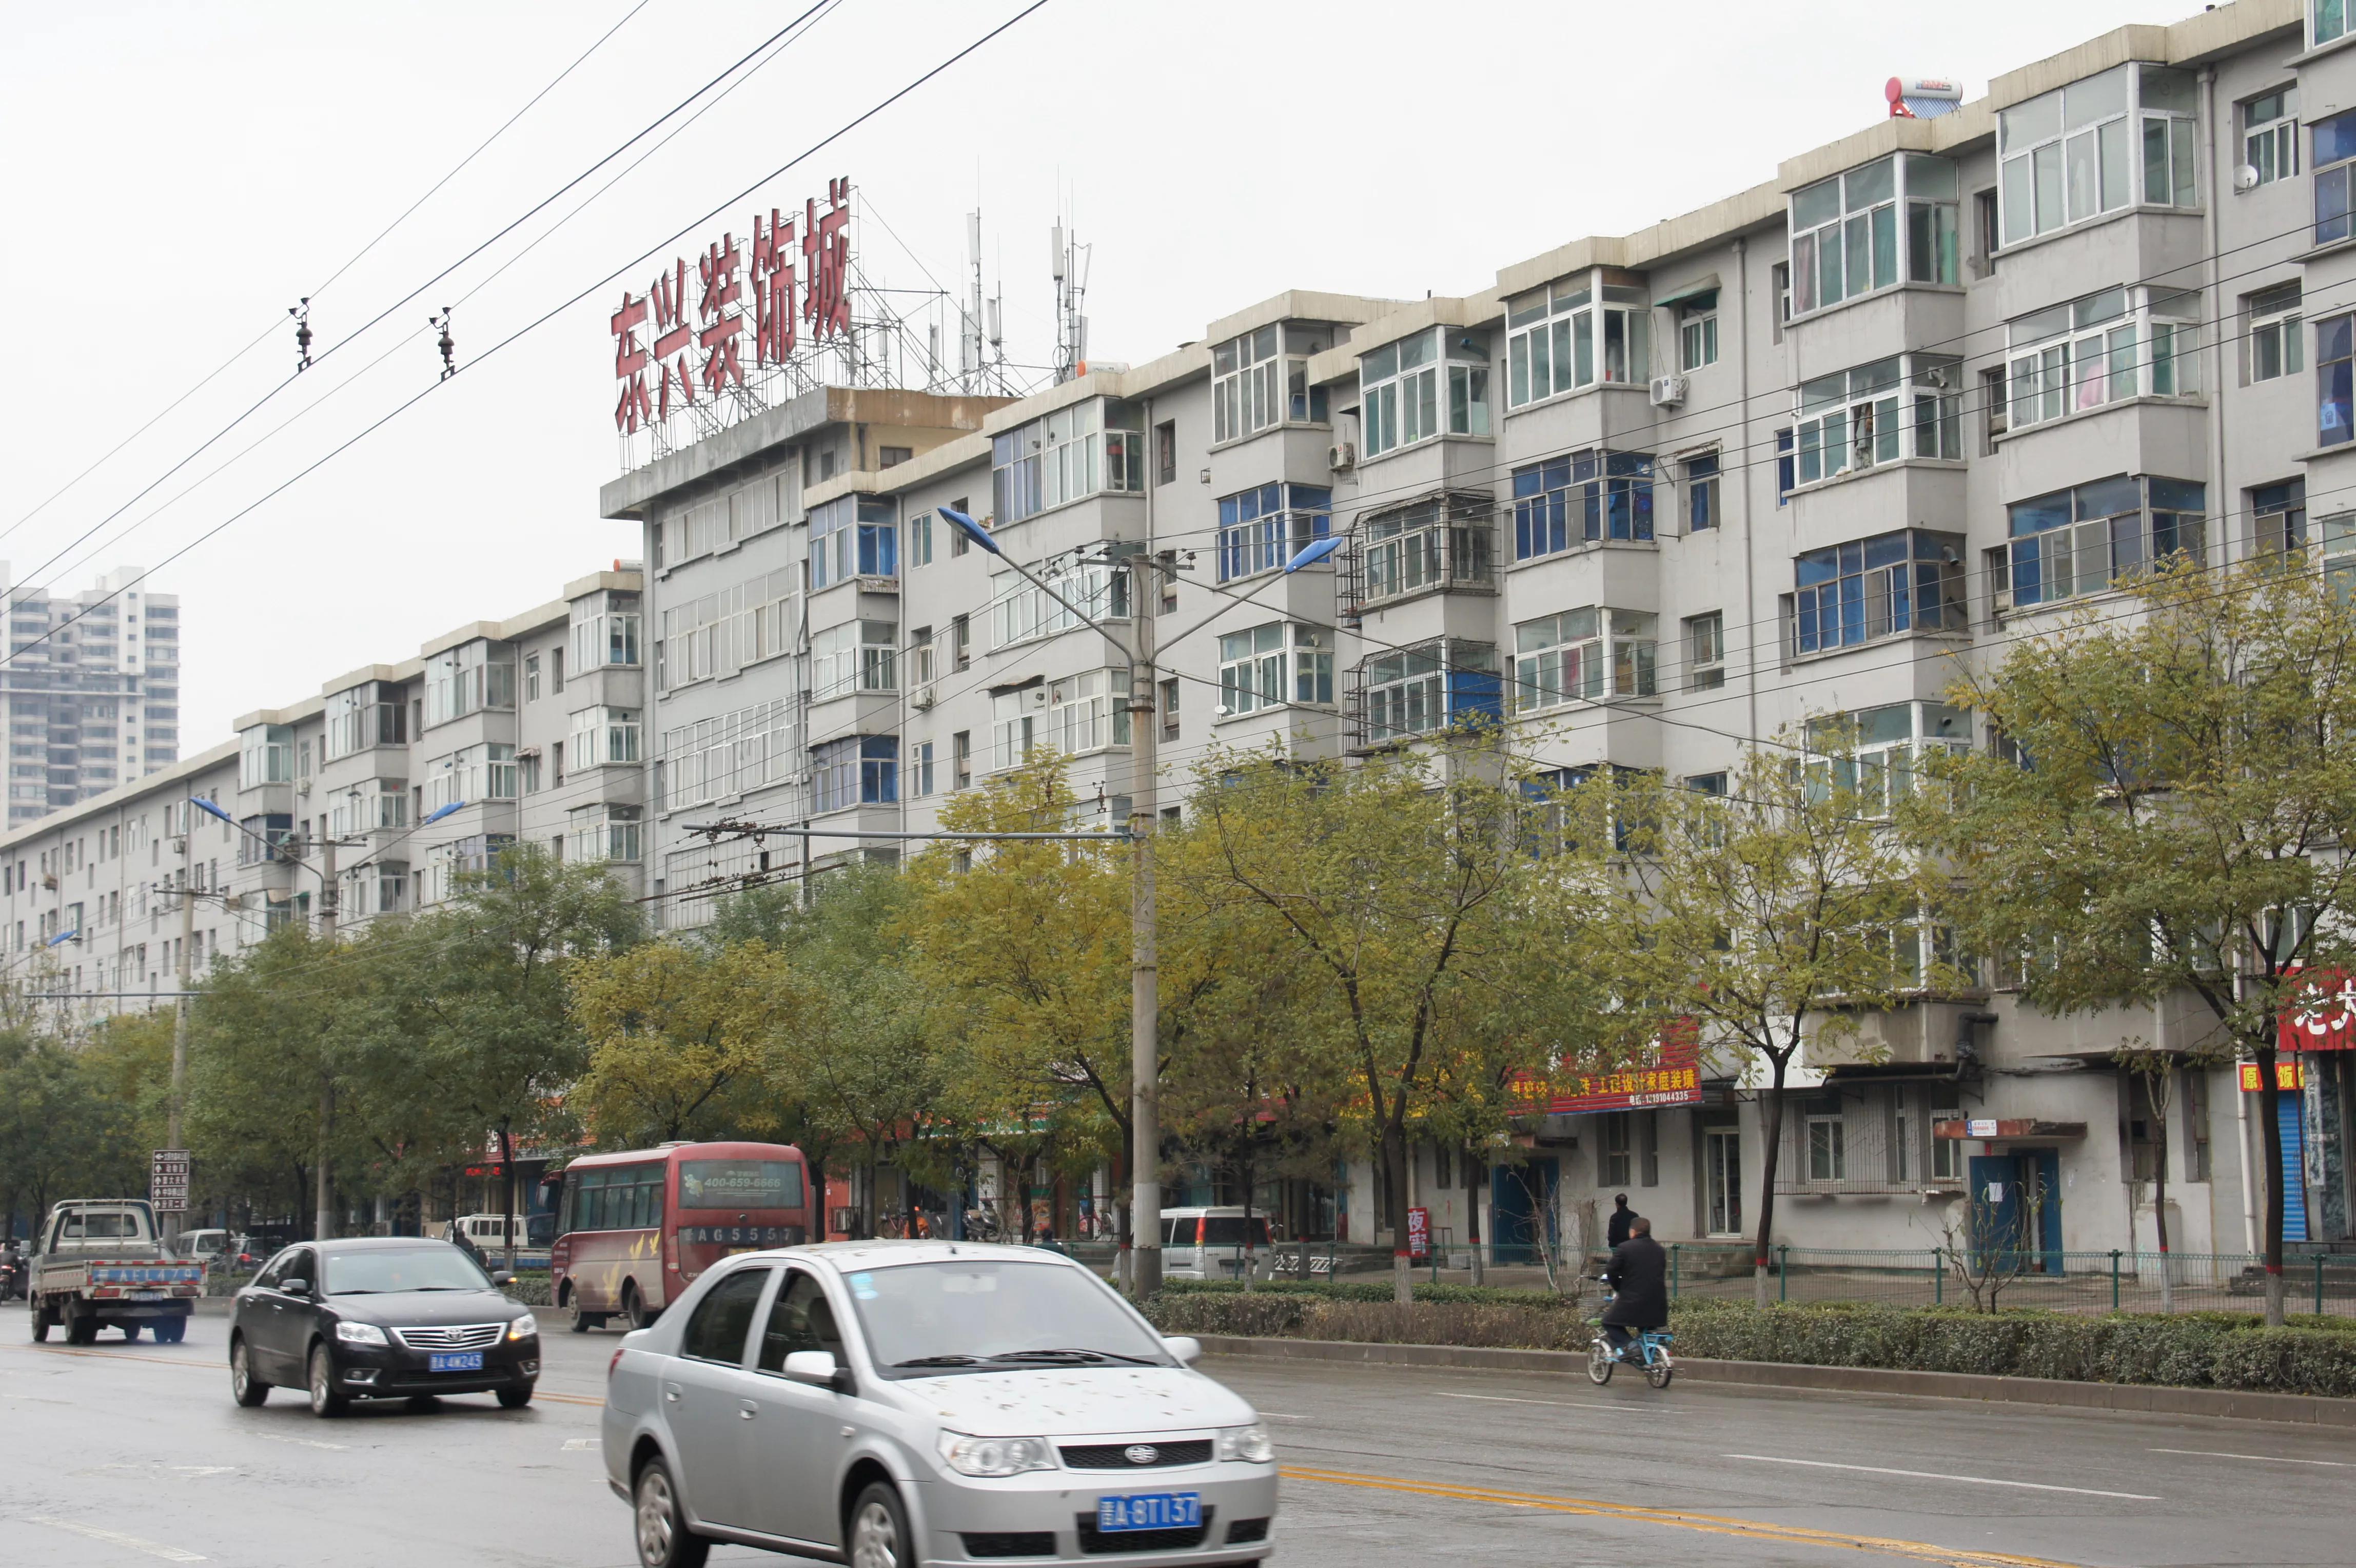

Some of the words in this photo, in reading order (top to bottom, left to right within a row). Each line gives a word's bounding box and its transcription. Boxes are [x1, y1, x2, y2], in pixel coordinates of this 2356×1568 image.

[611, 175, 852, 436] 东兴装饰城
[1407, 1210, 1427, 1255] 夜宵
